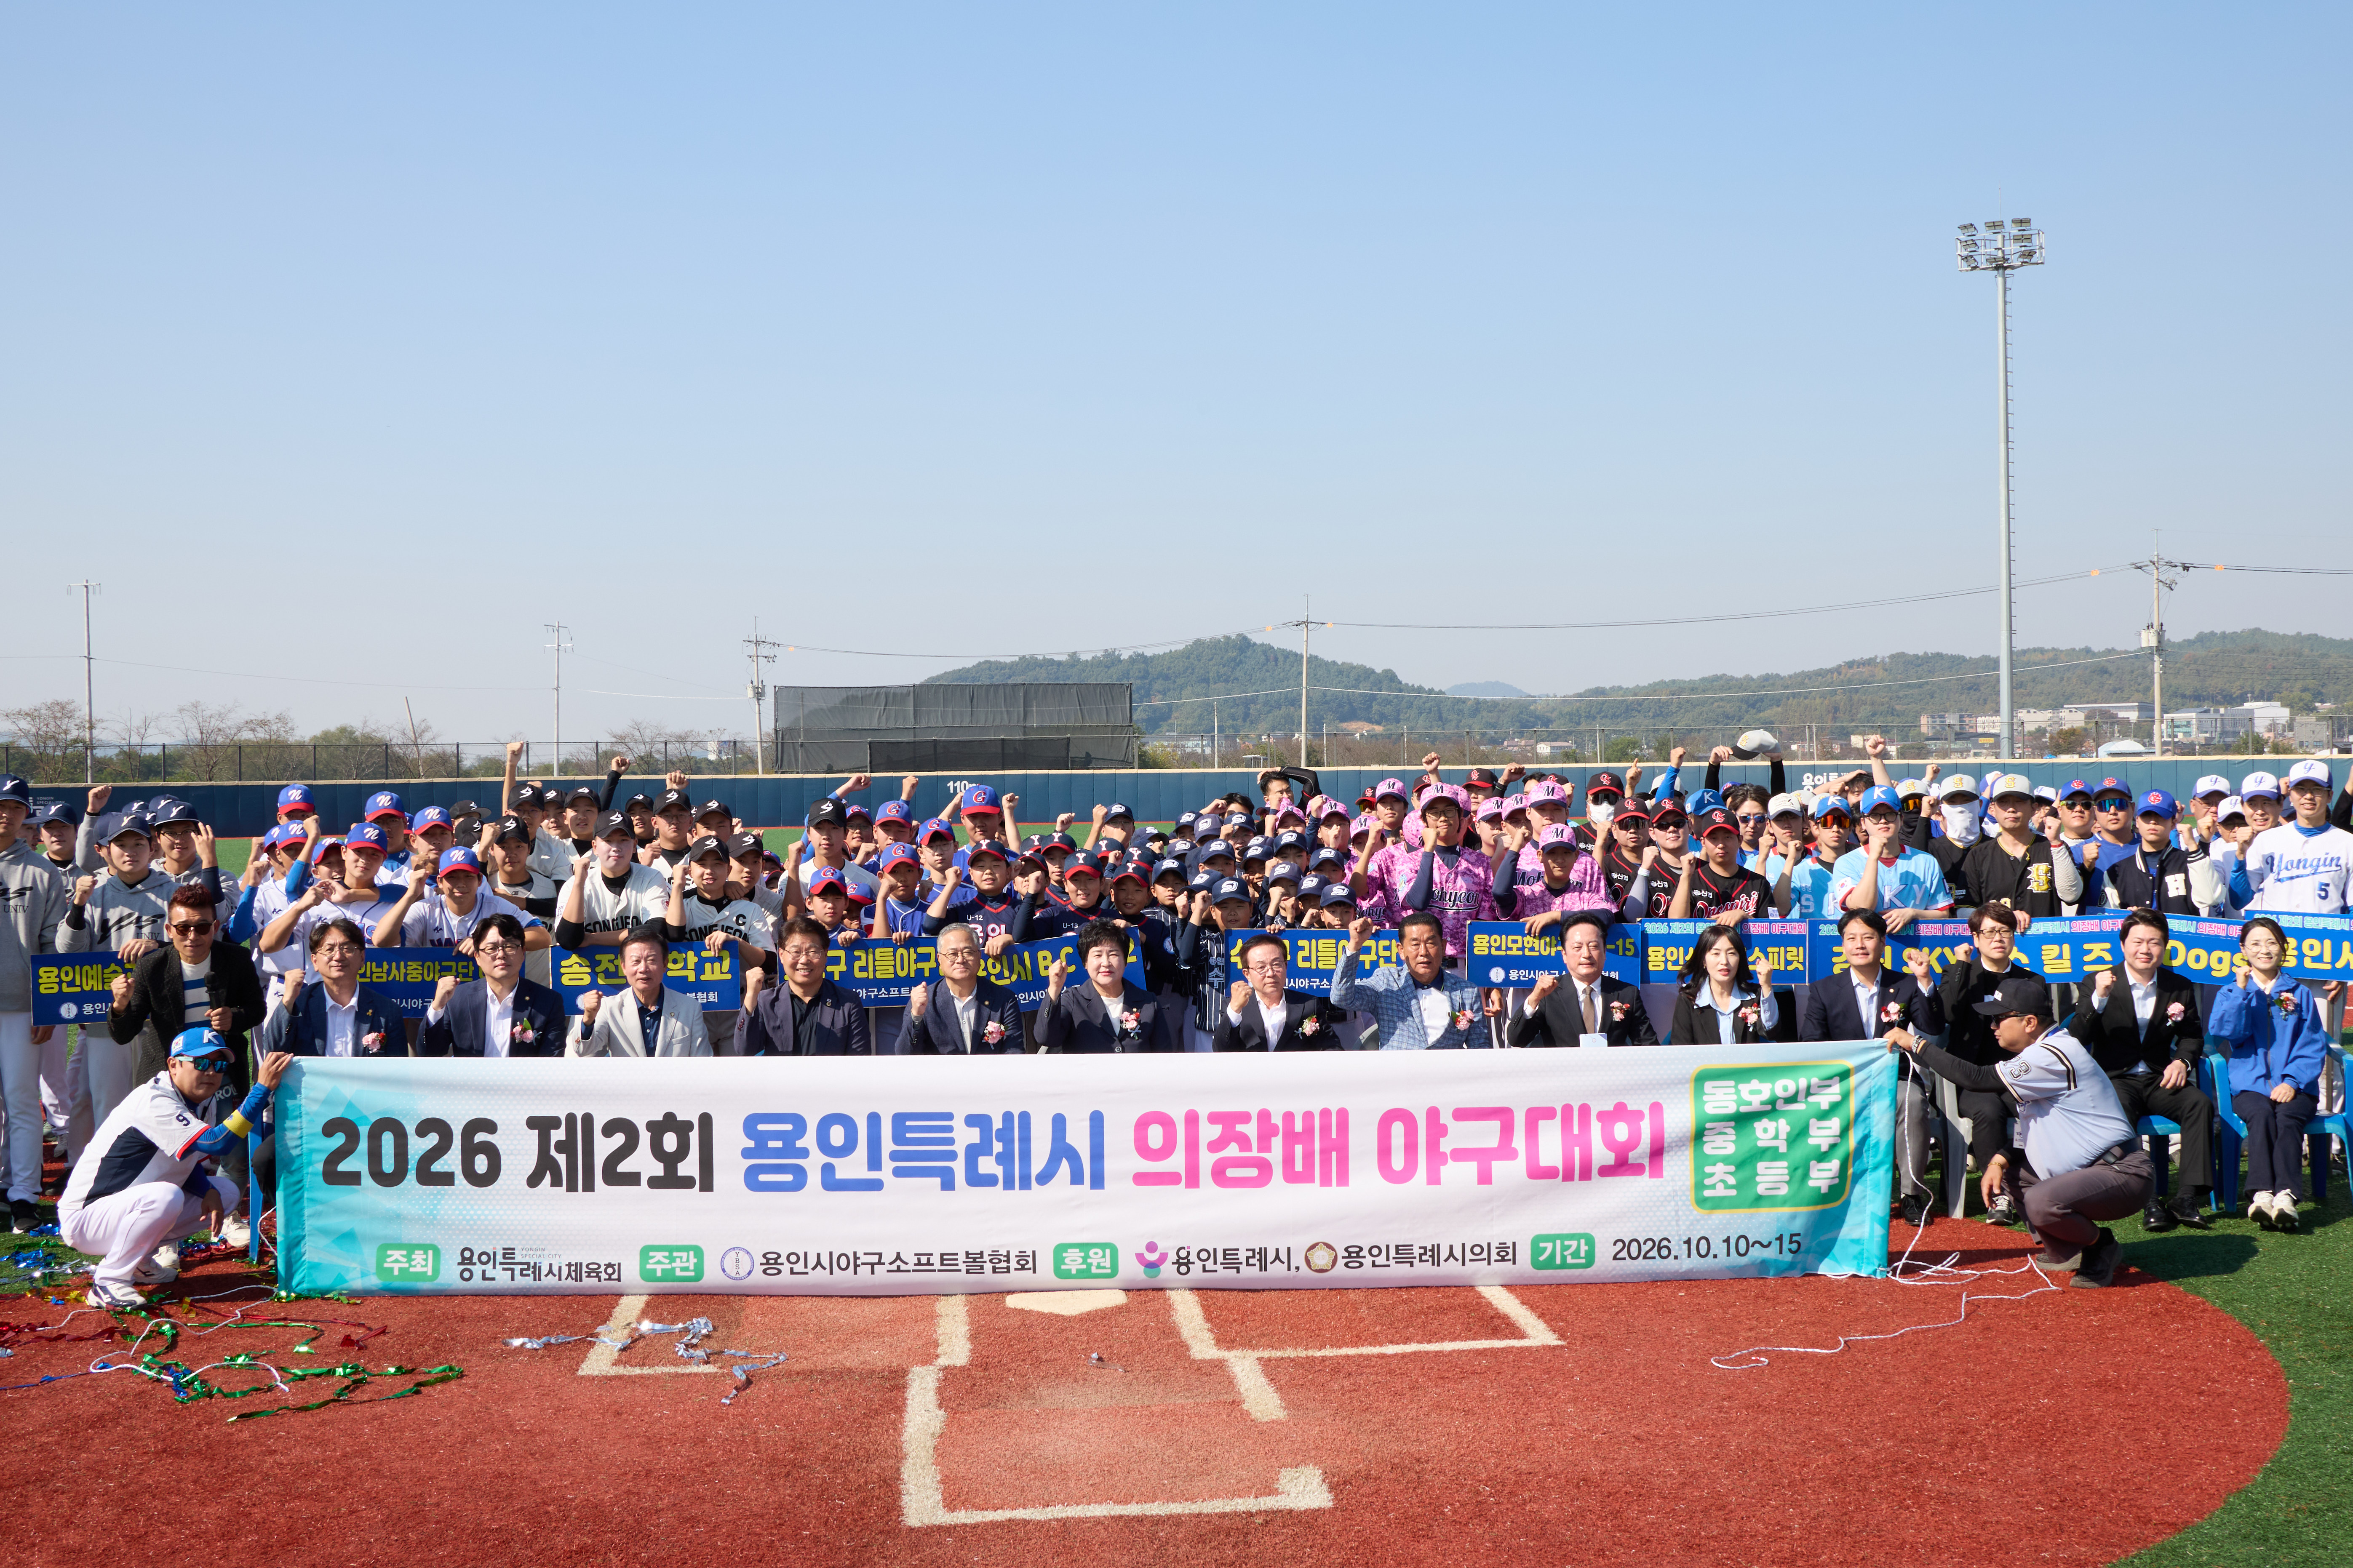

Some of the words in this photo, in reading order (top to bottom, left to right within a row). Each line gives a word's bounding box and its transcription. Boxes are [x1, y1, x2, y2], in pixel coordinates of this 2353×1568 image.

[1704, 792, 1715, 804] K
[1827, 796, 1842, 805] K
[1873, 786, 1888, 800] K
[2027, 862, 2052, 893] S
[2165, 873, 2187, 898] H
[2317, 882, 2330, 901] 5
[3, 905, 29, 913] UNIV
[735, 914, 747, 926] C
[1645, 923, 1668, 935] 2026
[1670, 922, 1694, 934] 제2회
[1742, 922, 1769, 935] 의장배
[1771, 922, 1806, 935] 야구대회
[1819, 924, 1840, 936] 202
[1915, 923, 1941, 936] 의장배
[1943, 923, 1971, 936] 야구대
[2071, 920, 2099, 933] 의장배
[2101, 919, 2124, 932] 야구
[2197, 922, 2226, 936] 의장배
[2303, 916, 2350, 930] 용인특례시
[853, 946, 945, 979] 리틀야구
[203, 1030, 220, 1045] K
[1703, 1076, 1842, 1115] 동호인부
[321, 1117, 502, 1188] 2026
[526, 1111, 714, 1192] 제2회
[740, 1109, 1105, 1192] 용인특례시
[1132, 1107, 1349, 1189] 의장배
[1377, 1101, 1665, 1186] 야구대회
[1703, 1121, 1736, 1155] 중
[1754, 1117, 1789, 1153] 학
[1808, 1117, 1840, 1152] 부
[1703, 1162, 1737, 1197] 초
[1755, 1161, 1789, 1195] 등
[1808, 1159, 1840, 1193] 부
[1341, 1241, 1517, 1269] 용인특례시의회
[1537, 1240, 1588, 1264] 기간
[1612, 1232, 1802, 1261] 2026.10.10~15
[383, 1249, 433, 1276] 주최
[646, 1250, 697, 1277] 주관
[759, 1249, 1037, 1277] 용인시야구소프트볼협회
[1061, 1248, 1111, 1274] 후원
